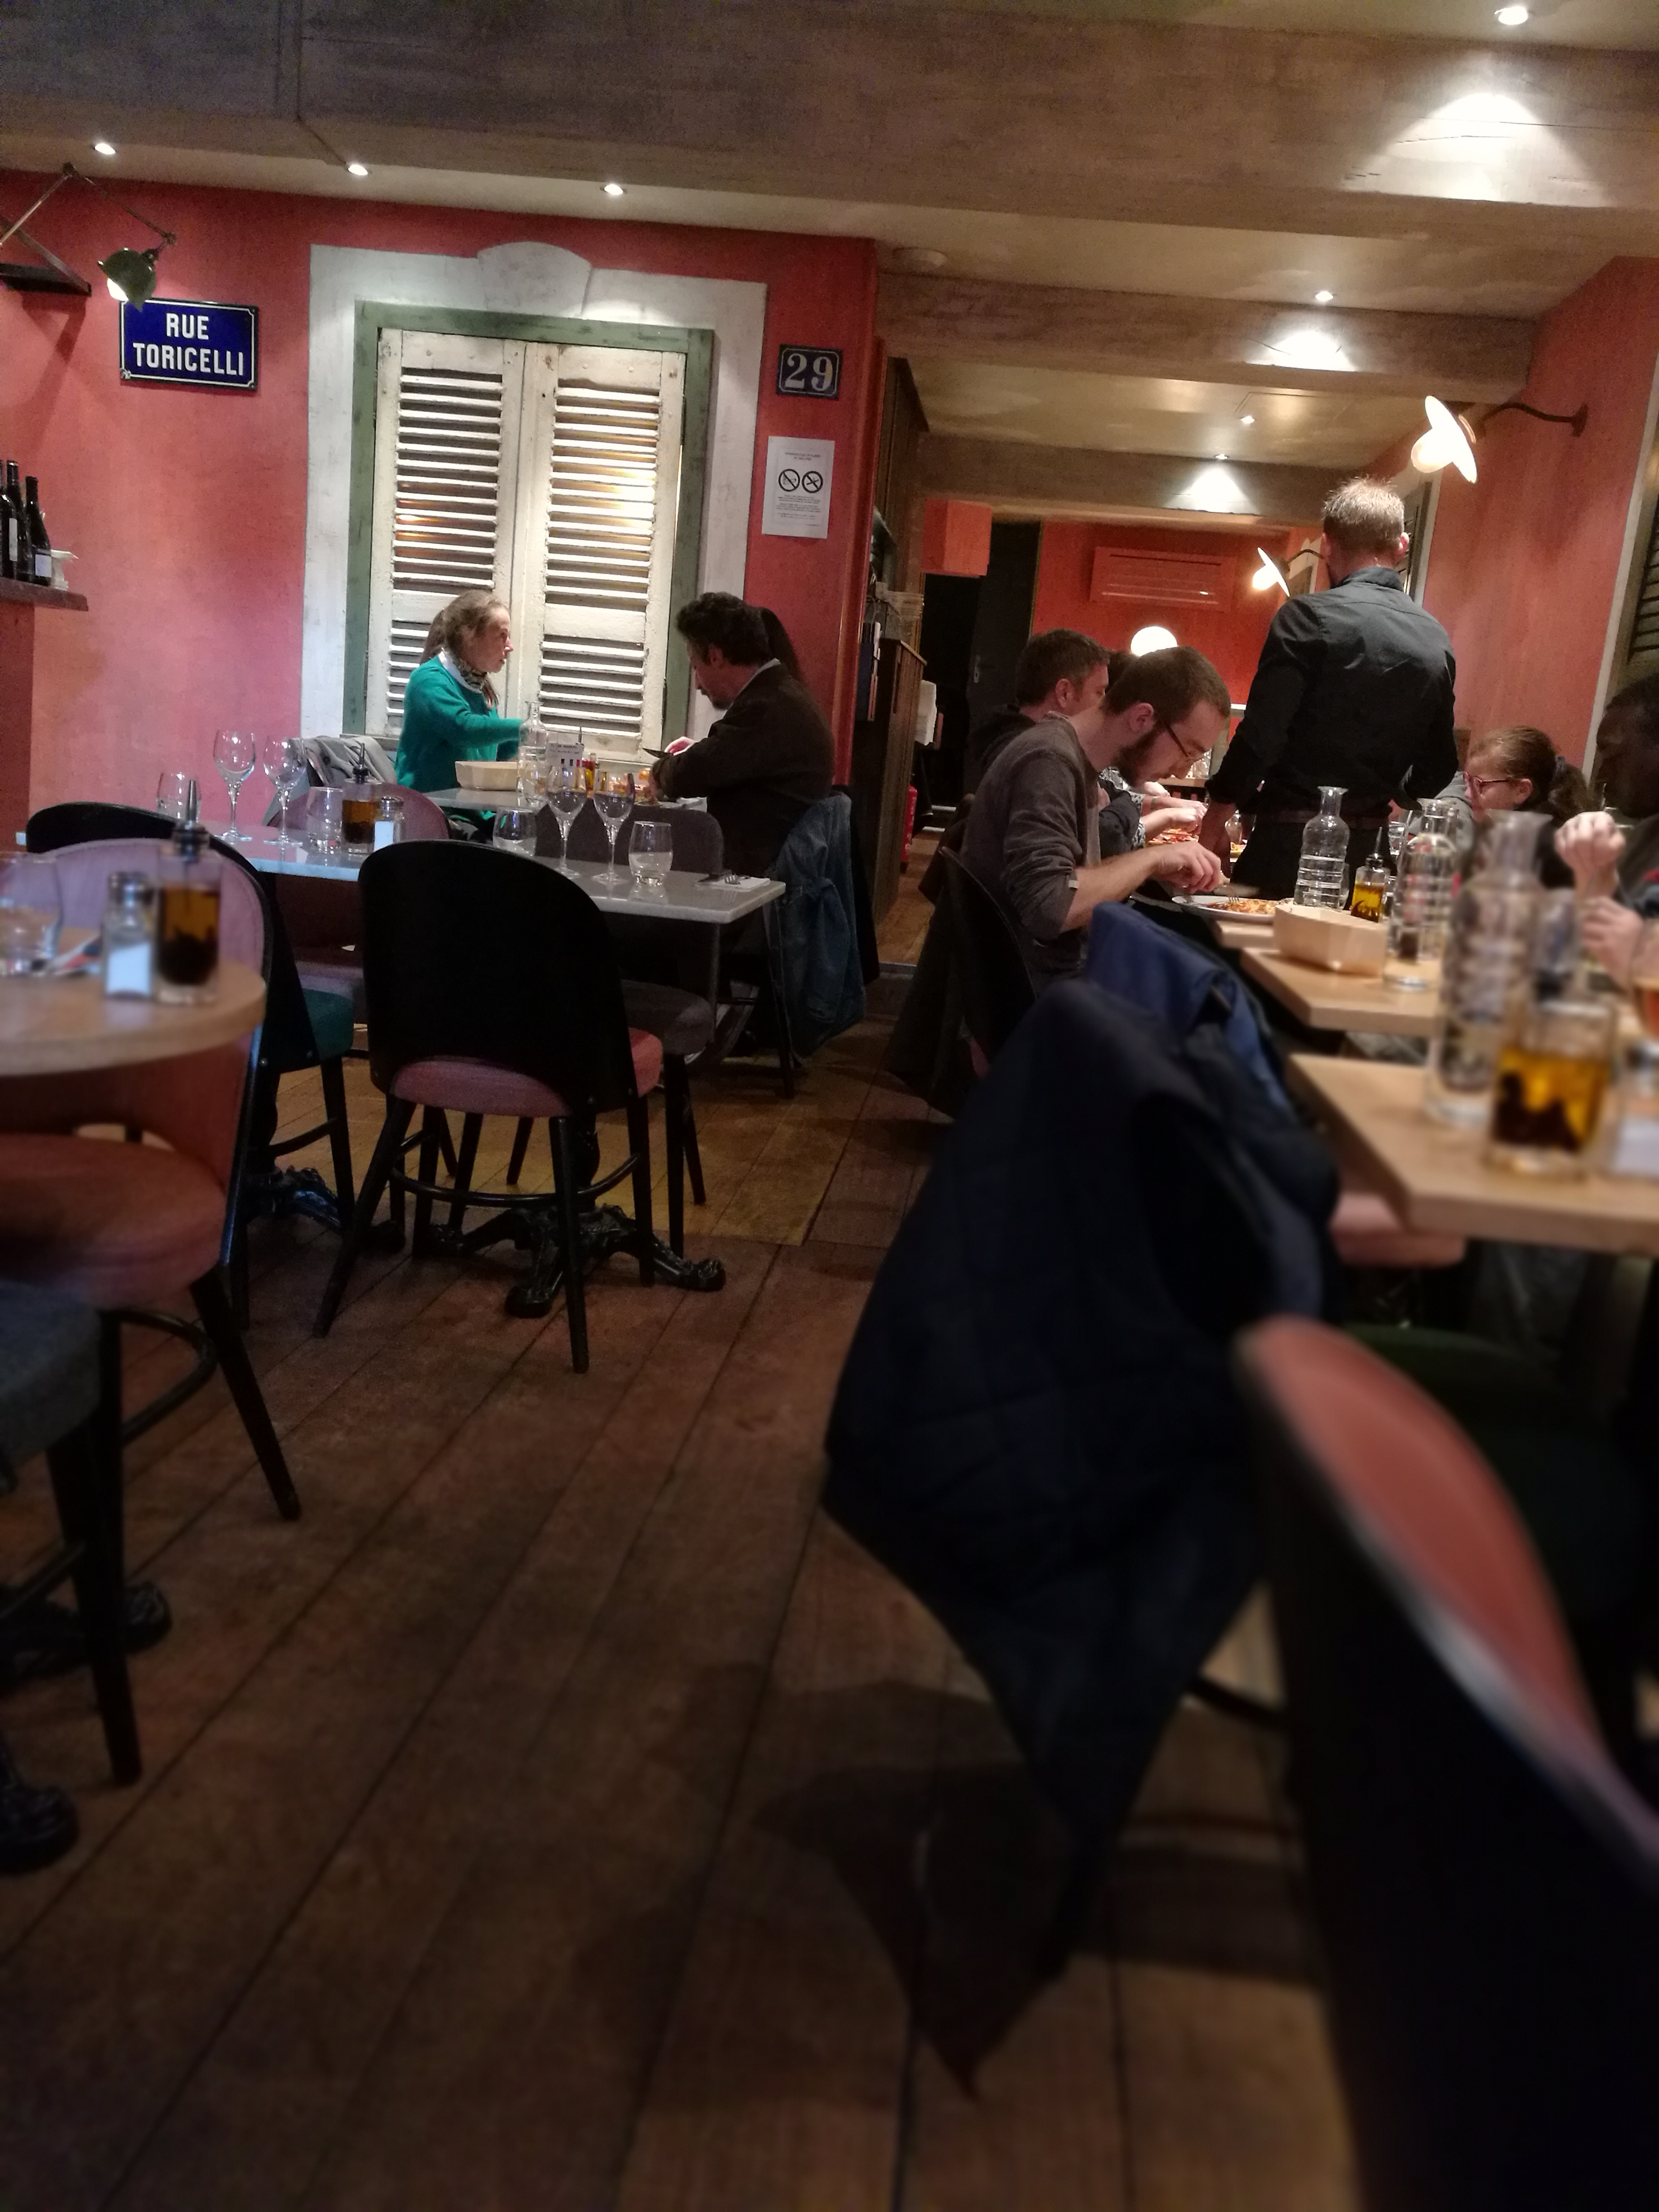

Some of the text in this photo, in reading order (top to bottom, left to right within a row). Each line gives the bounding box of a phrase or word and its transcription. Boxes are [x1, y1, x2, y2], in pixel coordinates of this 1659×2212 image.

[166, 312, 210, 340] RUE
[132, 342, 244, 376] TORICELLI
[785, 353, 833, 391] 29
